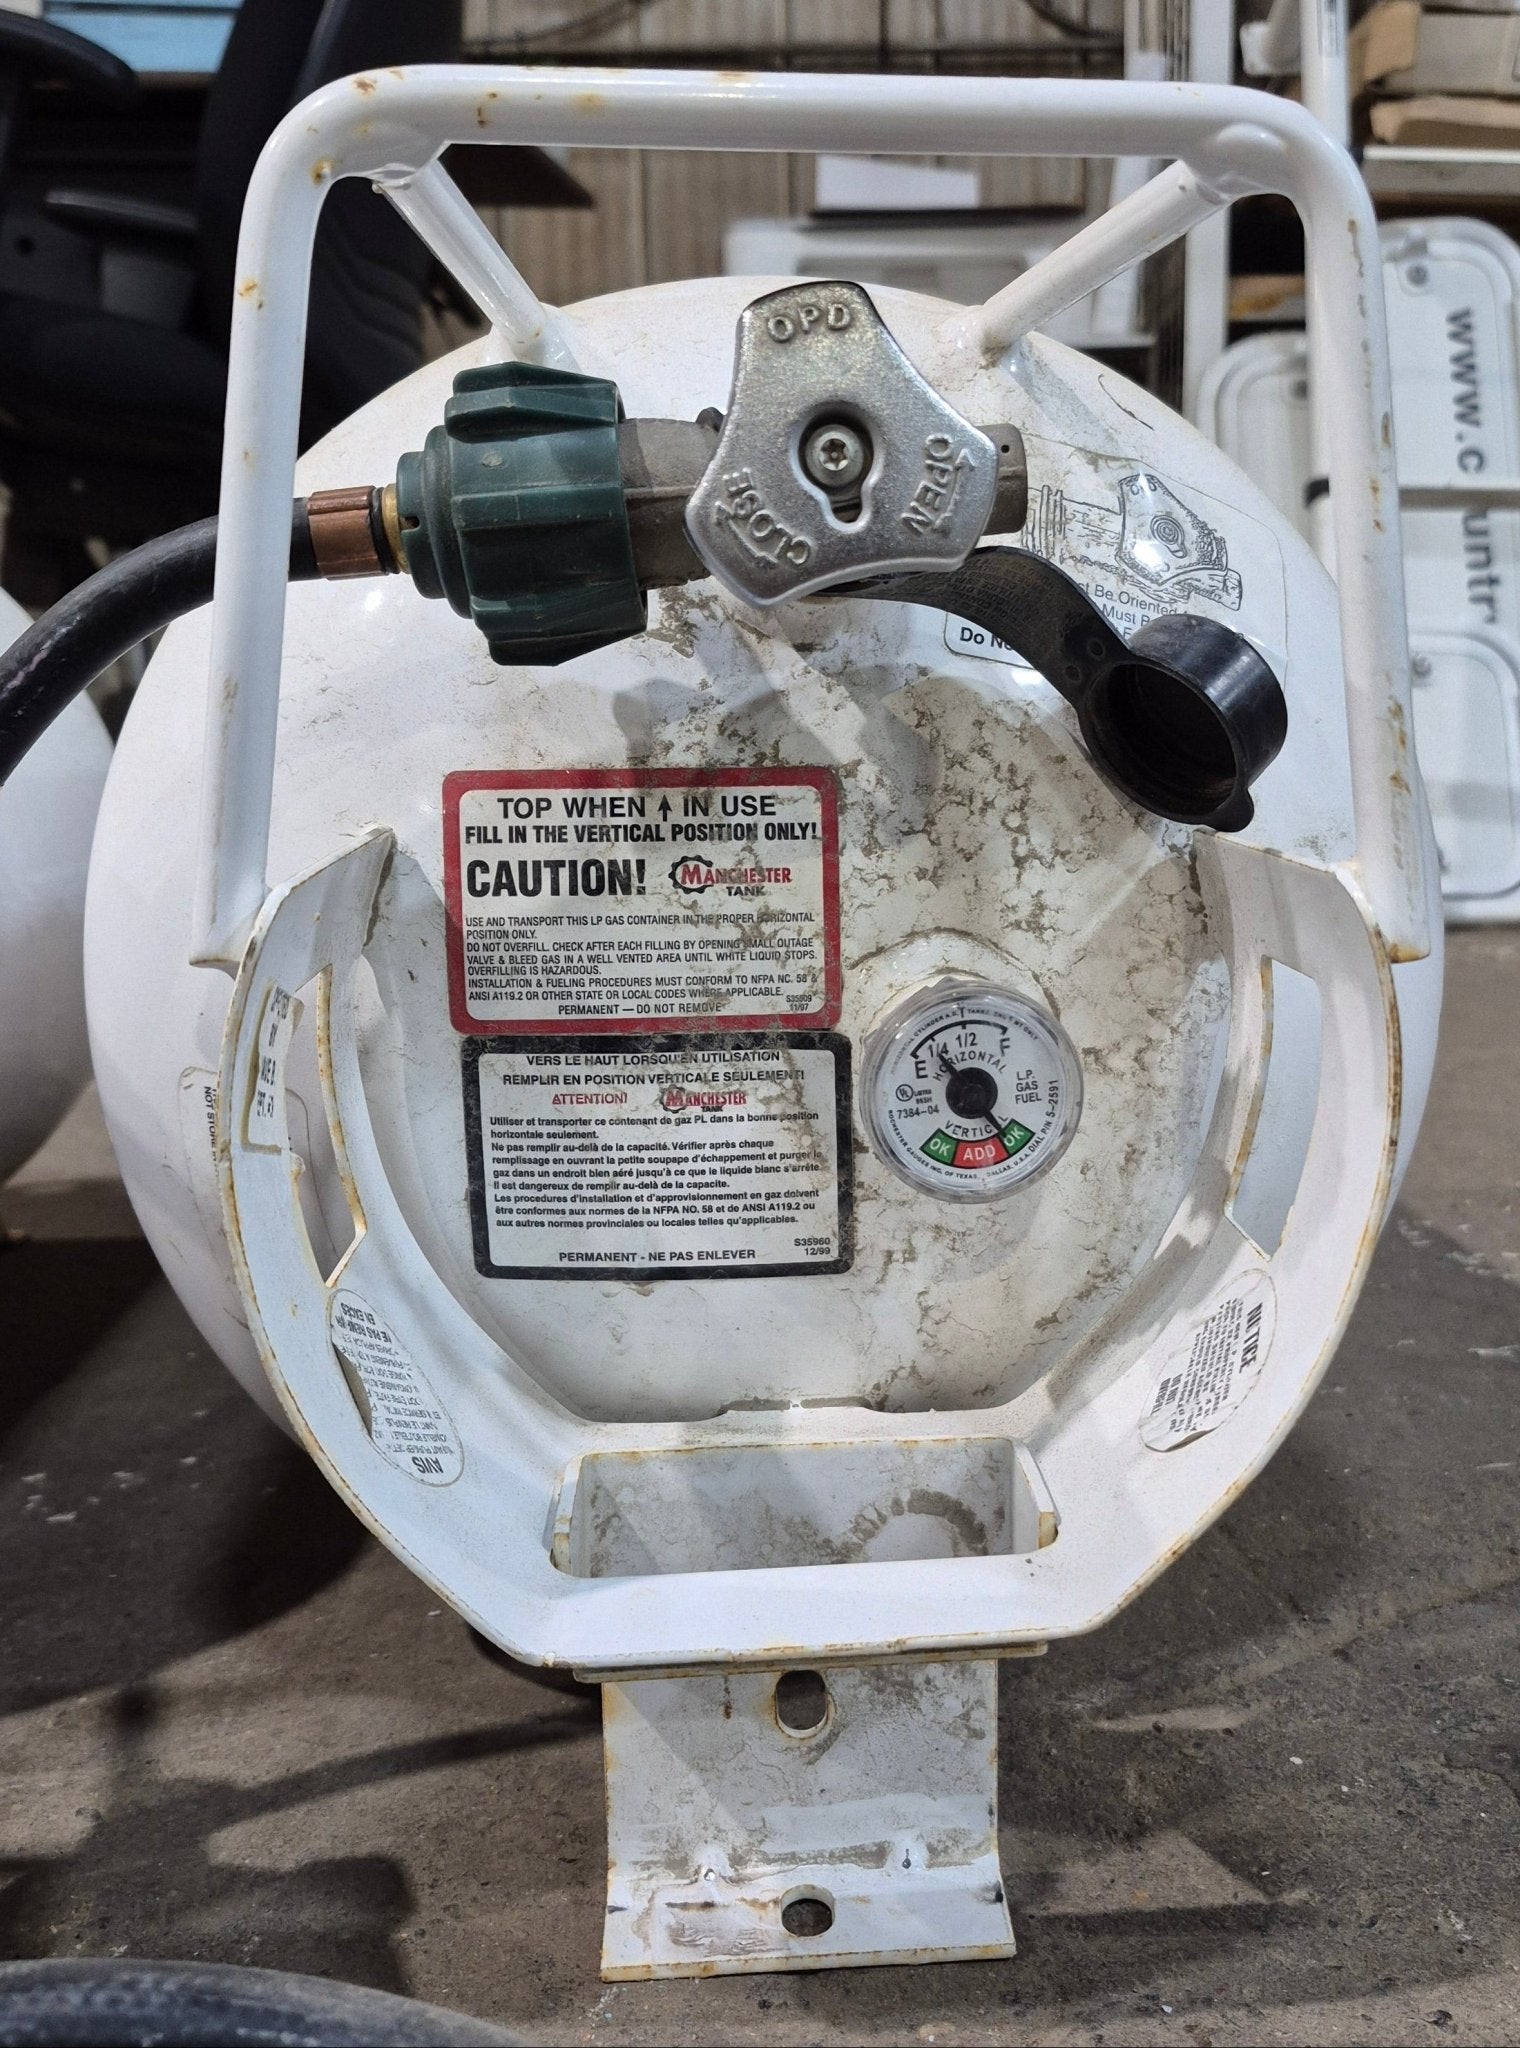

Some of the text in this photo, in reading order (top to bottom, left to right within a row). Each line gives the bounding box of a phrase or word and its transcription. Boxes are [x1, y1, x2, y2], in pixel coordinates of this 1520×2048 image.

[766, 302, 851, 343] OPD
[901, 434, 953, 535] OPEN
[721, 466, 812, 565] CLOSE
[1094, 585, 1114, 599] Be
[1118, 591, 1178, 616] Oriented
[1101, 604, 1137, 624] Must
[960, 627, 985, 645] Do
[497, 795, 776, 819] TOP WHEN IN USE
[465, 822, 817, 844] FILL IN THE VERTICAL POSITION ONLY!
[467, 859, 646, 897] CAUTION!
[680, 864, 792, 885] MANCHESTER
[726, 886, 766, 896] TANK
[466, 917, 483, 927] USE
[486, 917, 505, 926] AND
[508, 916, 564, 926] TRANSPORT
[566, 916, 588, 925] THIS
[591, 916, 602, 925] LP
[605, 916, 624, 925] GAS
[627, 914, 680, 925] CONTAINER
[683, 914, 693, 924] IN
[695, 914, 715, 924] THE
[717, 914, 754, 923] PROPER
[466, 929, 537, 939] POSITION ONLY.
[467, 943, 480, 952] DO
[483, 943, 501, 952] NOT
[553, 942, 583, 951] CHECK
[586, 941, 615, 951] AFTER
[617, 941, 642, 951] EACH
[645, 940, 680, 950] FILLING
[684, 940, 696, 950] BY
[699, 939, 740, 949] OPENING
[777, 938, 813, 948] OUTAGE
[467, 950, 817, 965] VALVE & BLEED GAS IN A WELL VENTED AREA UNTIL WHITE LIQUID STOPS.
[468, 965, 601, 976] OVERFILLING IS HAZARDOUS.
[468, 978, 532, 989] INSTALLATION
[536, 979, 543, 988] &
[546, 978, 585, 988] FUELING
[588, 977, 652, 987] PROCEDURES
[655, 976, 682, 986] MUST
[685, 975, 732, 986] CONFORM
[735, 975, 747, 985] TO
[751, 975, 775, 984] NFPA
[796, 974, 807, 983] 58
[469, 992, 490, 1001] ANSI
[493, 992, 523, 1000] A119.2
[526, 991, 538, 1000] OR
[542, 991, 572, 1000] OTHER
[575, 990, 603, 999] STATE
[606, 990, 619, 999] OR
[622, 989, 652, 999] LOCAL
[655, 989, 686, 999] CODES
[725, 987, 784, 996] APPLICABLE.
[558, 1003, 721, 1015] PERMANENT DO NOT REMOVE
[955, 1032, 978, 1048] 1/2
[1000, 1037, 1010, 1057] F
[928, 1042, 949, 1058] 1/4
[526, 1051, 780, 1066] VERS LE HAUT LORSQU'EN UTILISATION
[915, 1060, 928, 1079] E
[1017, 1069, 1035, 1080] L.P.
[503, 1075, 559, 1085] REMPLIR
[563, 1075, 580, 1085] EN
[584, 1074, 645, 1084] POSITION
[1016, 1081, 1038, 1092] GAS
[204, 1086, 213, 1110] NOT
[552, 1092, 628, 1105] ATTENTION!
[1015, 1092, 1042, 1104] FUEL
[897, 1105, 939, 1119] 7384-04
[1028, 1135, 1045, 1152] DIAL
[1046, 1079, 1059, 1118] 5-2591
[491, 1129, 599, 1139] horizontale seulement.
[945, 1116, 1008, 1138] VERTICL
[888, 1109, 908, 1147] ROCHESTER
[907, 1147, 929, 1167] GAUGES
[1004, 1126, 1025, 1147] OK
[929, 1138, 952, 1156] OK
[963, 1145, 996, 1160] ADD
[496, 1219, 513, 1227] aux
[516, 1219, 545, 1227] autres
[586, 1218, 644, 1229] provinciales
[647, 1219, 659, 1227] ou
[662, 1218, 696, 1227] locales
[699, 1217, 724, 1226] telles
[727, 1215, 798, 1227] qu'applicables.
[559, 1250, 755, 1262] PERMANENT NE PAS ENLEVER
[804, 1248, 831, 1256] 12/99
[365, 1312, 374, 1326] EN
[412, 1456, 444, 1474] AVIS
